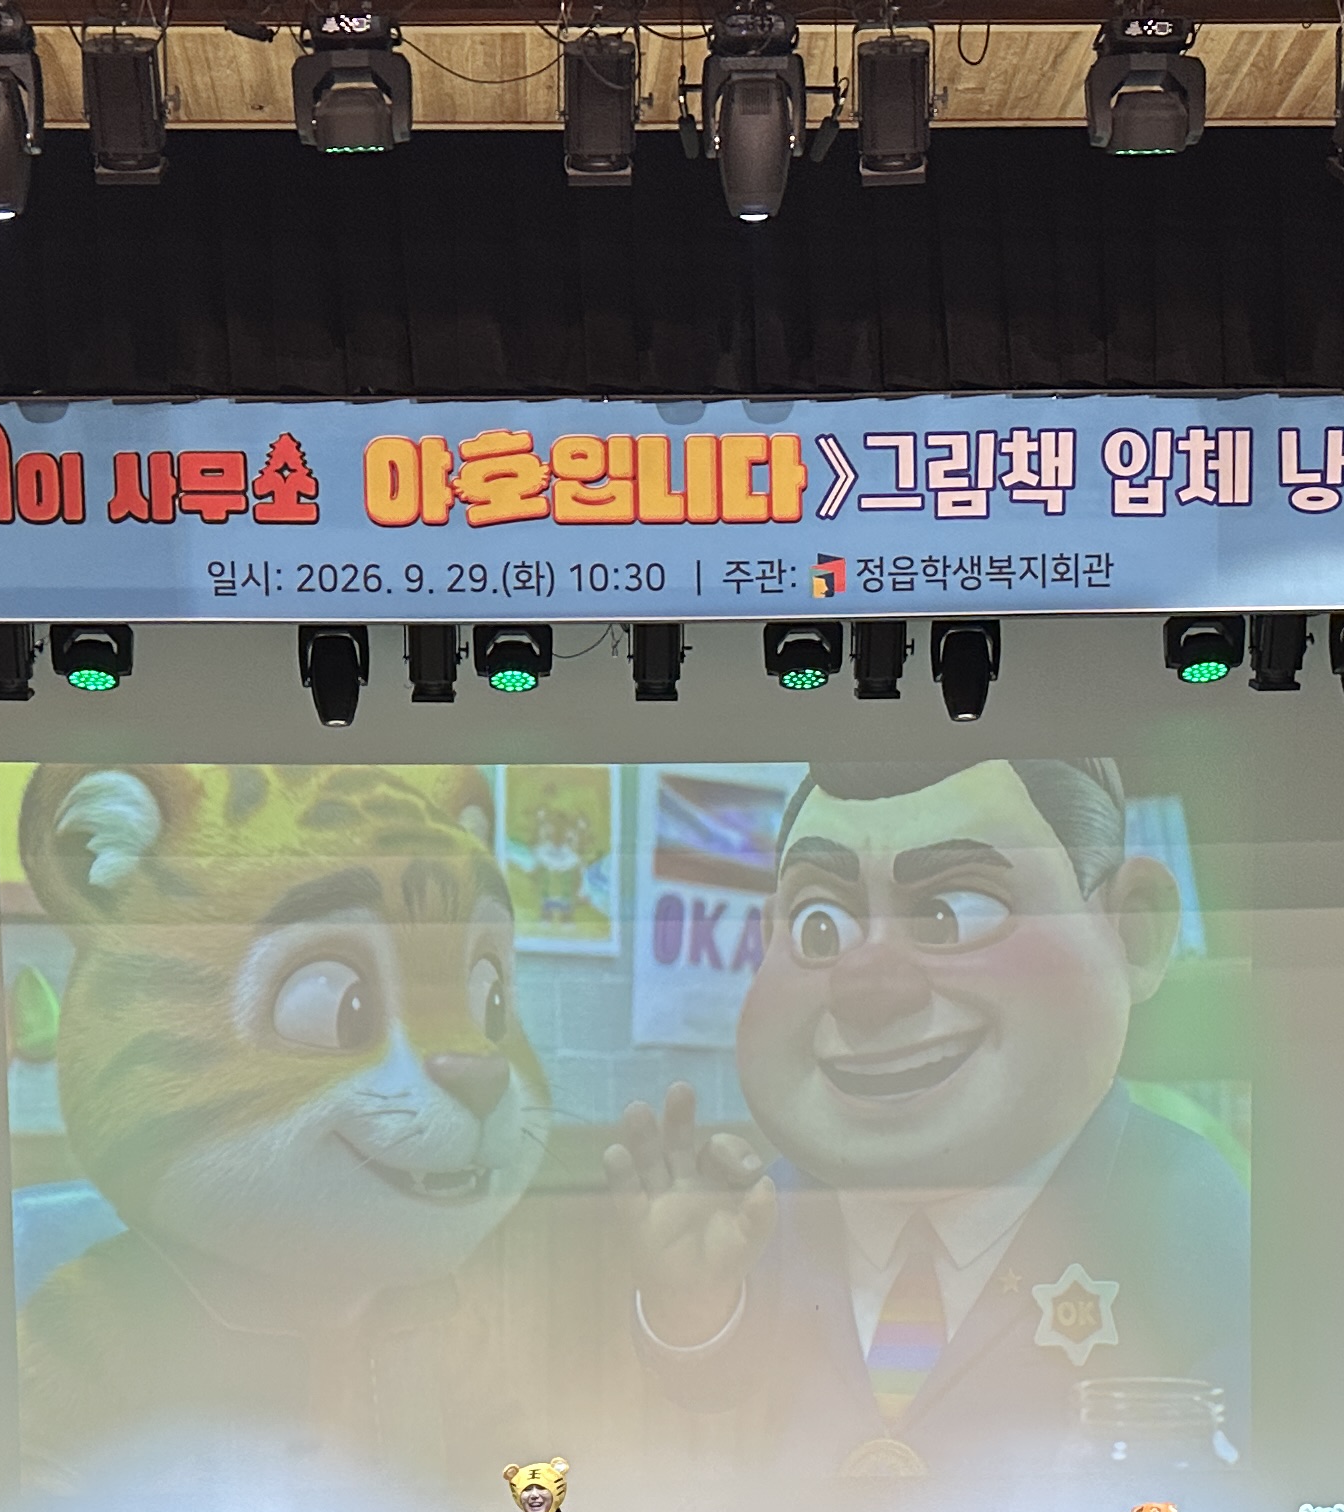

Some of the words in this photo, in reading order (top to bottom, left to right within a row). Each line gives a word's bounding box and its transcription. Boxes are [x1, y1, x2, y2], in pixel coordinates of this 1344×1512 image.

[107, 431, 319, 527] 사무소
[1101, 427, 1254, 518] 입체
[208, 561, 283, 597] 일시:
[296, 563, 392, 595] 2026.
[569, 562, 666, 592] 10:30
[722, 559, 797, 595] 주관:
[856, 553, 1115, 593] 정읍학생복지회관
[1056, 1301, 1098, 1327] OK
